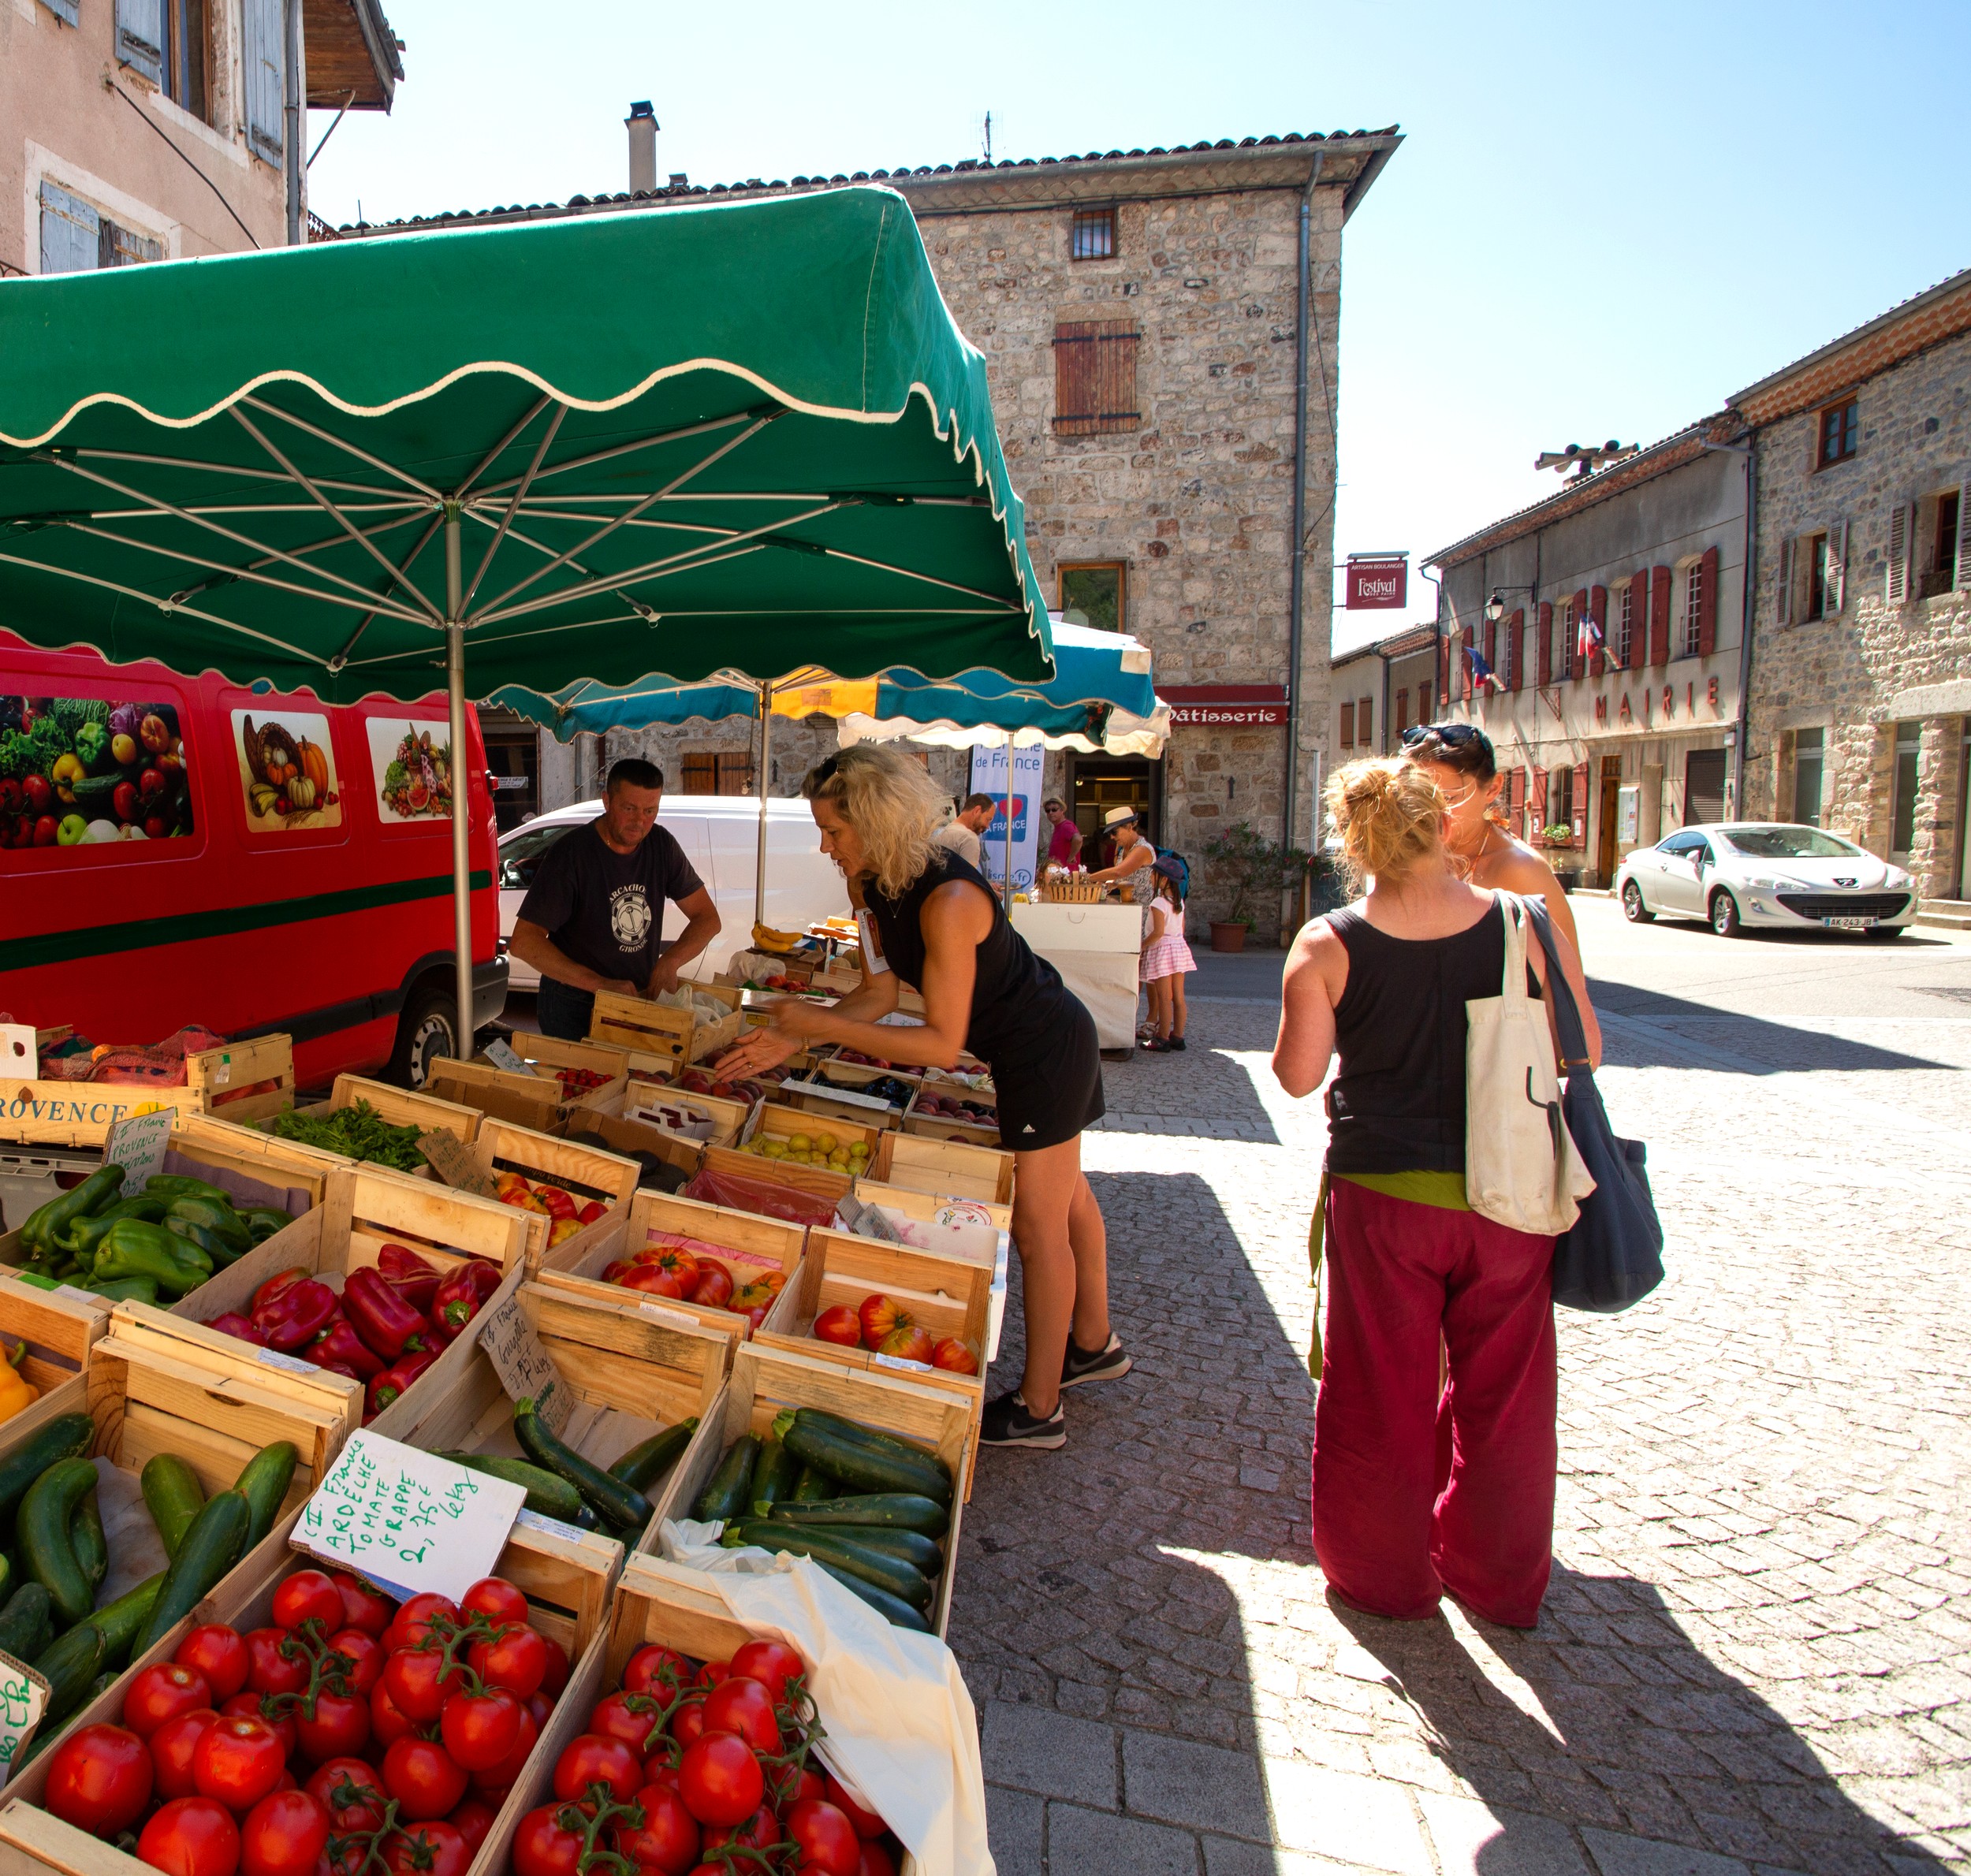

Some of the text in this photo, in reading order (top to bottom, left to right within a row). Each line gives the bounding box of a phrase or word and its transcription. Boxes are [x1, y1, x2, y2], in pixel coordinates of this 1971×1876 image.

[1358, 578, 1396, 597] Festival
[1595, 677, 1719, 719] MAIRIE
[976, 756, 988, 768] de
[609, 884, 646, 904] ARCACHO
[619, 937, 648, 953] GIRONDE
[112, 1132, 159, 1162] PROVENCE
[350, 1477, 389, 1555] TOMATE
[378, 1469, 416, 1548] GRAPPE
